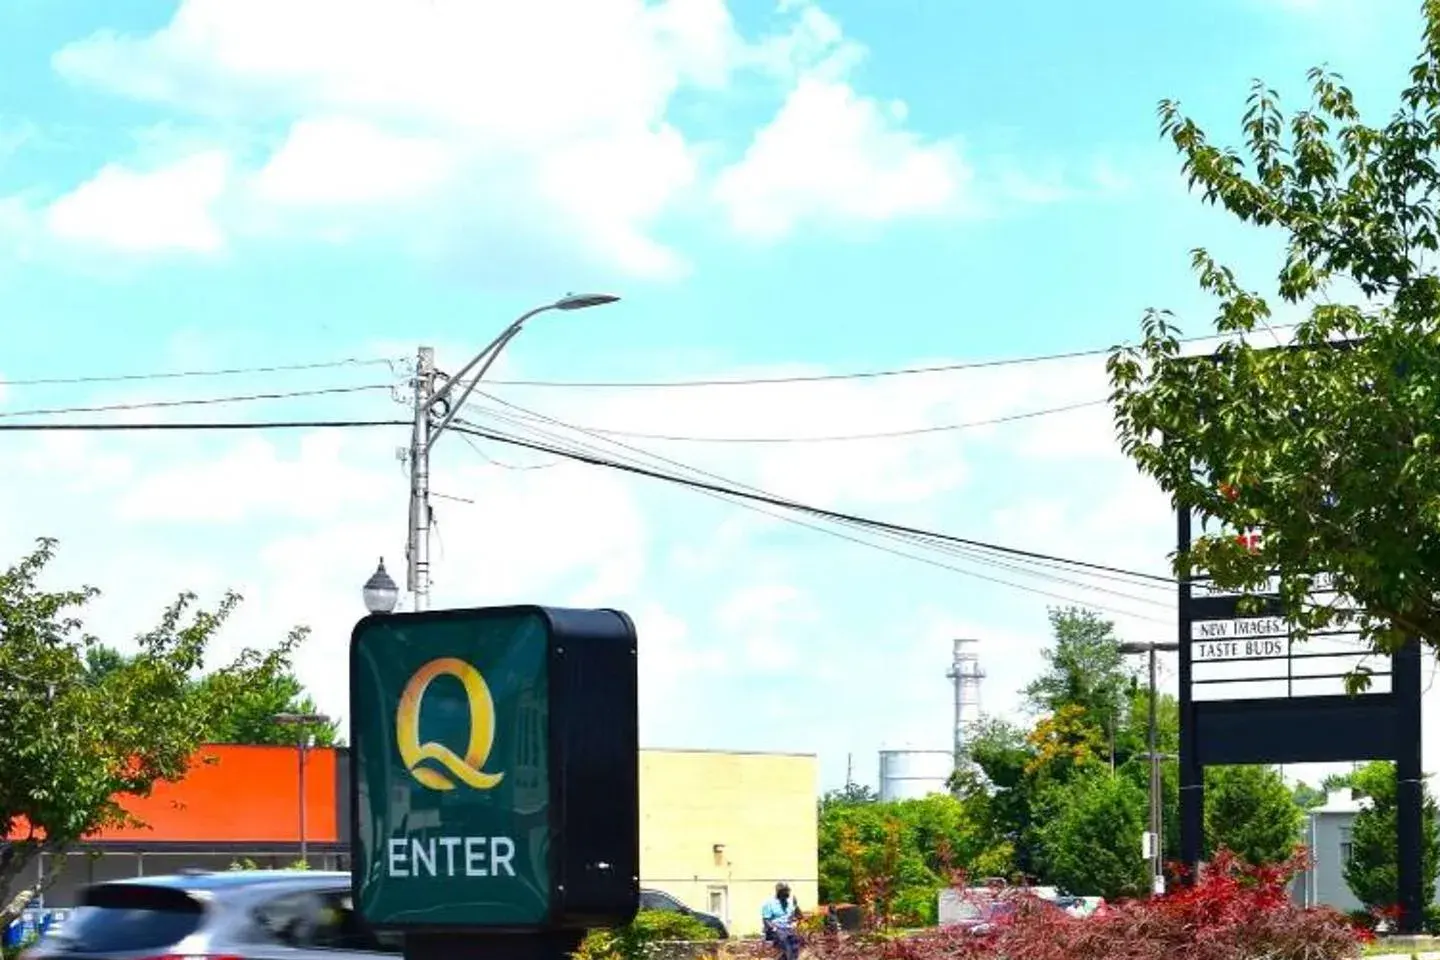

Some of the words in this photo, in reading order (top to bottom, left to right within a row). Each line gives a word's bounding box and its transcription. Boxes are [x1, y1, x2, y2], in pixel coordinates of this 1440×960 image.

[1200, 622, 1228, 637] NEW
[1233, 618, 1281, 635] IMAGES
[1200, 642, 1238, 658] TASTE
[1245, 640, 1282, 656] BUDS
[396, 657, 505, 791] Q
[387, 836, 517, 878] ENTER
